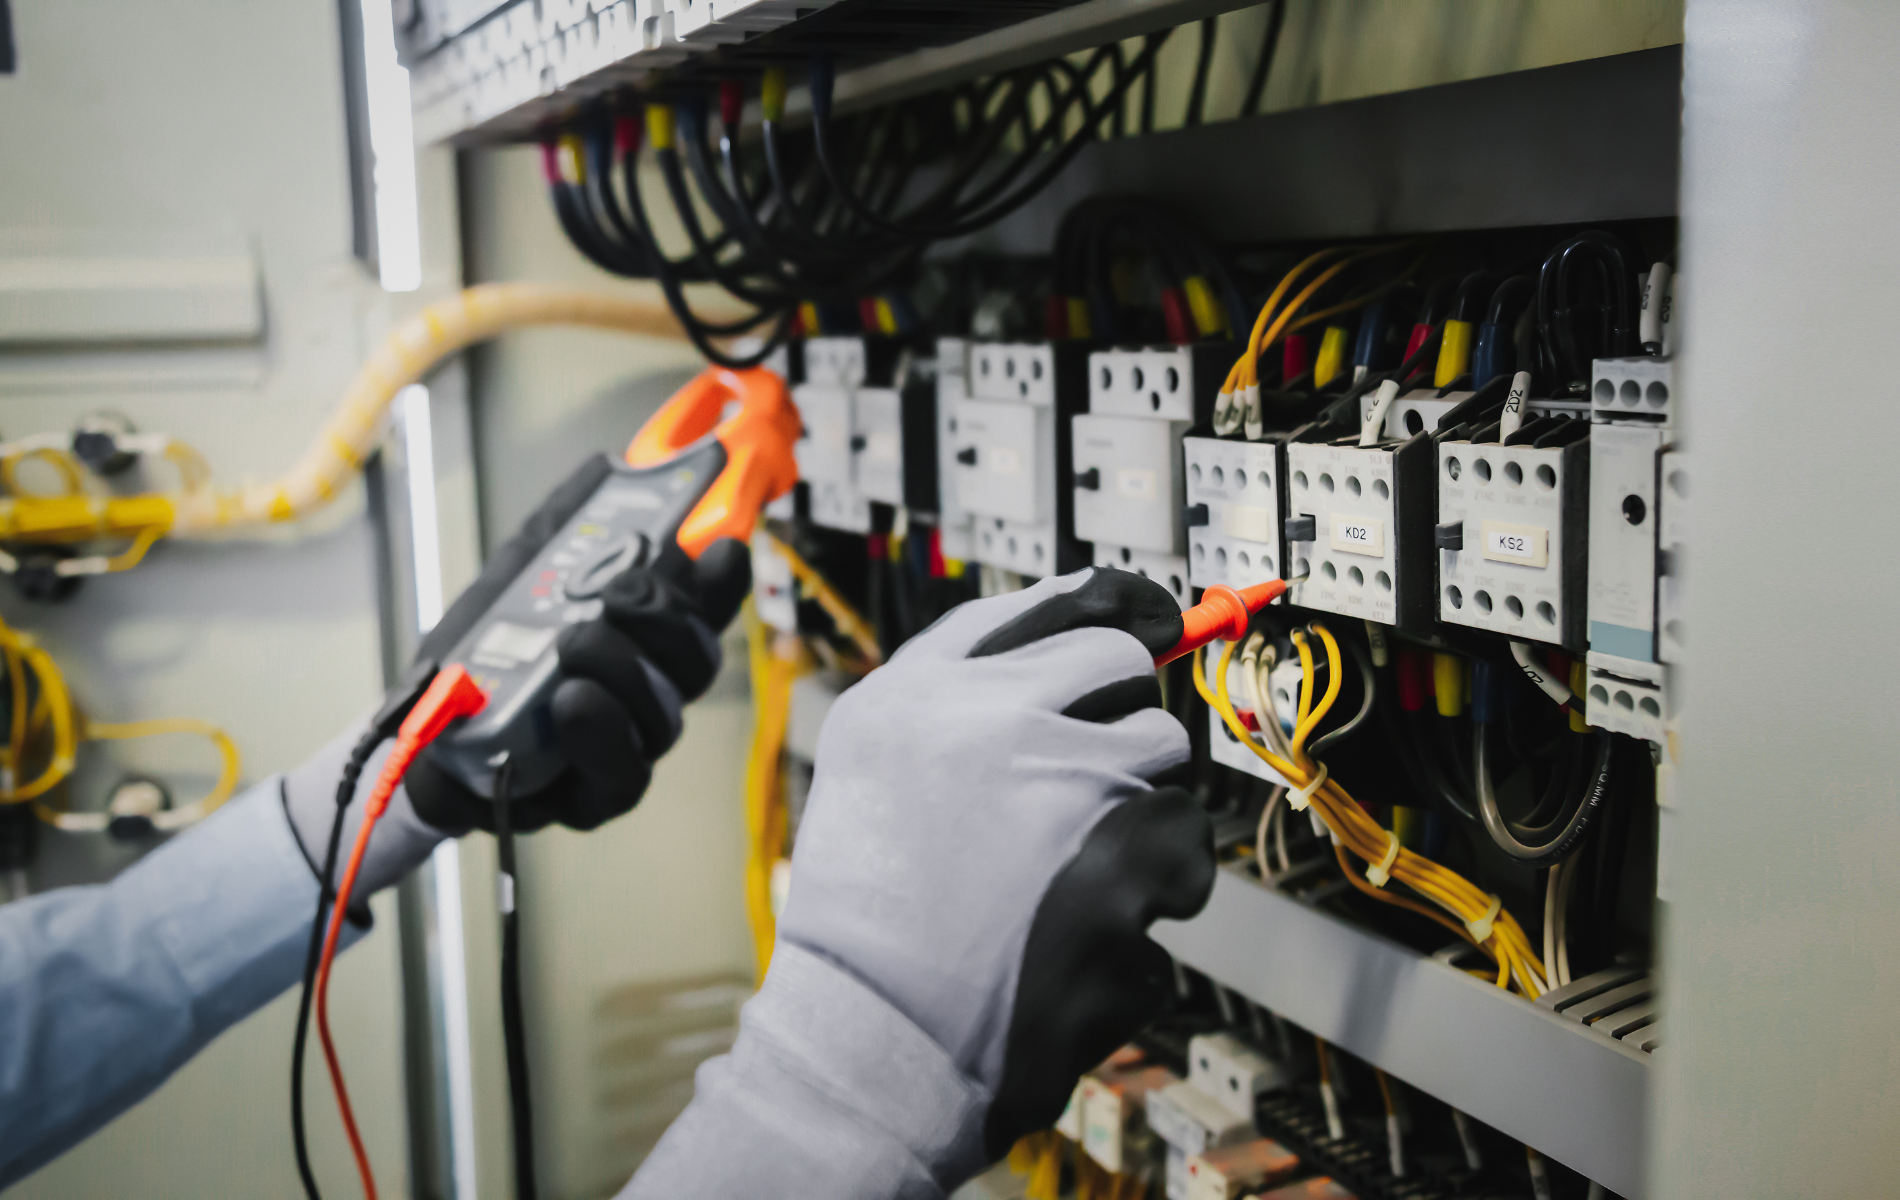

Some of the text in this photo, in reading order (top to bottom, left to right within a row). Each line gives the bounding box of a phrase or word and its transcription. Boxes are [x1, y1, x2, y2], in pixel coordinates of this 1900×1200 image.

[1505, 389, 1523, 413] 2D2
[1345, 525, 1367, 541] KD2
[1499, 535, 1524, 552] KS2
